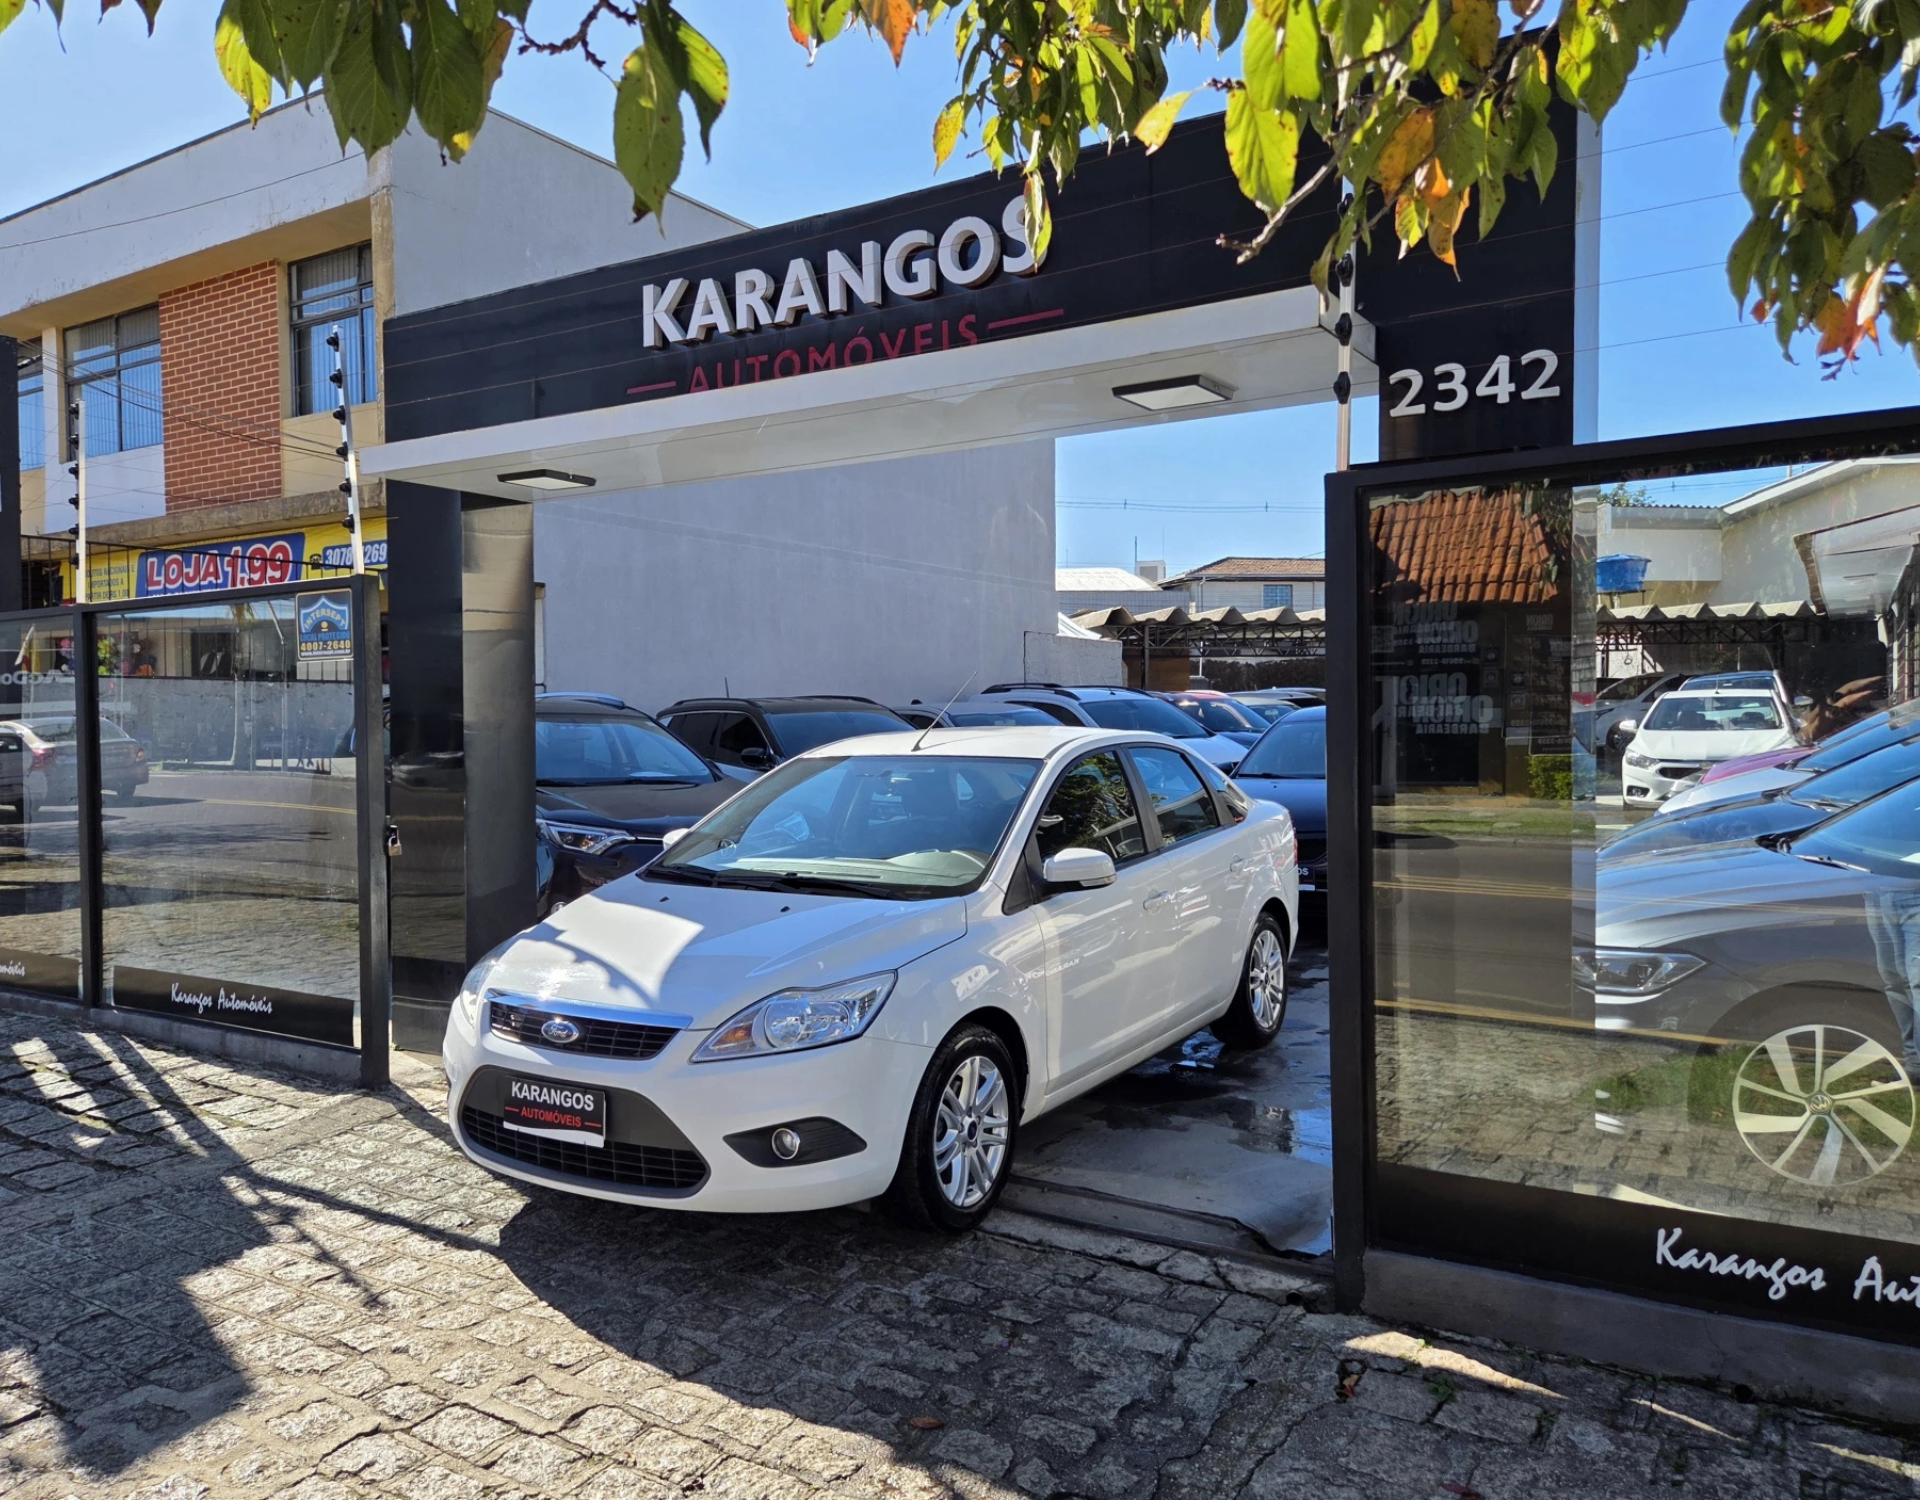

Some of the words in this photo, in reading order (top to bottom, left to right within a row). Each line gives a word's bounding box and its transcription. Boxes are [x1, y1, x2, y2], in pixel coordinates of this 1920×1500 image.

[642, 195, 1047, 350] KARANGOS
[689, 314, 977, 393] AUTOMÓVEIS
[1389, 349, 1560, 417] 2342
[147, 550, 222, 590] LOJA
[224, 541, 292, 588] 1.99
[304, 608, 346, 629] INTERSEPT
[300, 640, 351, 651] 4007-2640
[171, 982, 213, 1014] Karangos
[217, 987, 273, 1014] Automóveis
[511, 1081, 594, 1111] KARANGOS
[520, 1105, 582, 1127] AUTOMÓVEIS
[1656, 1227, 1827, 1300] Karangos
